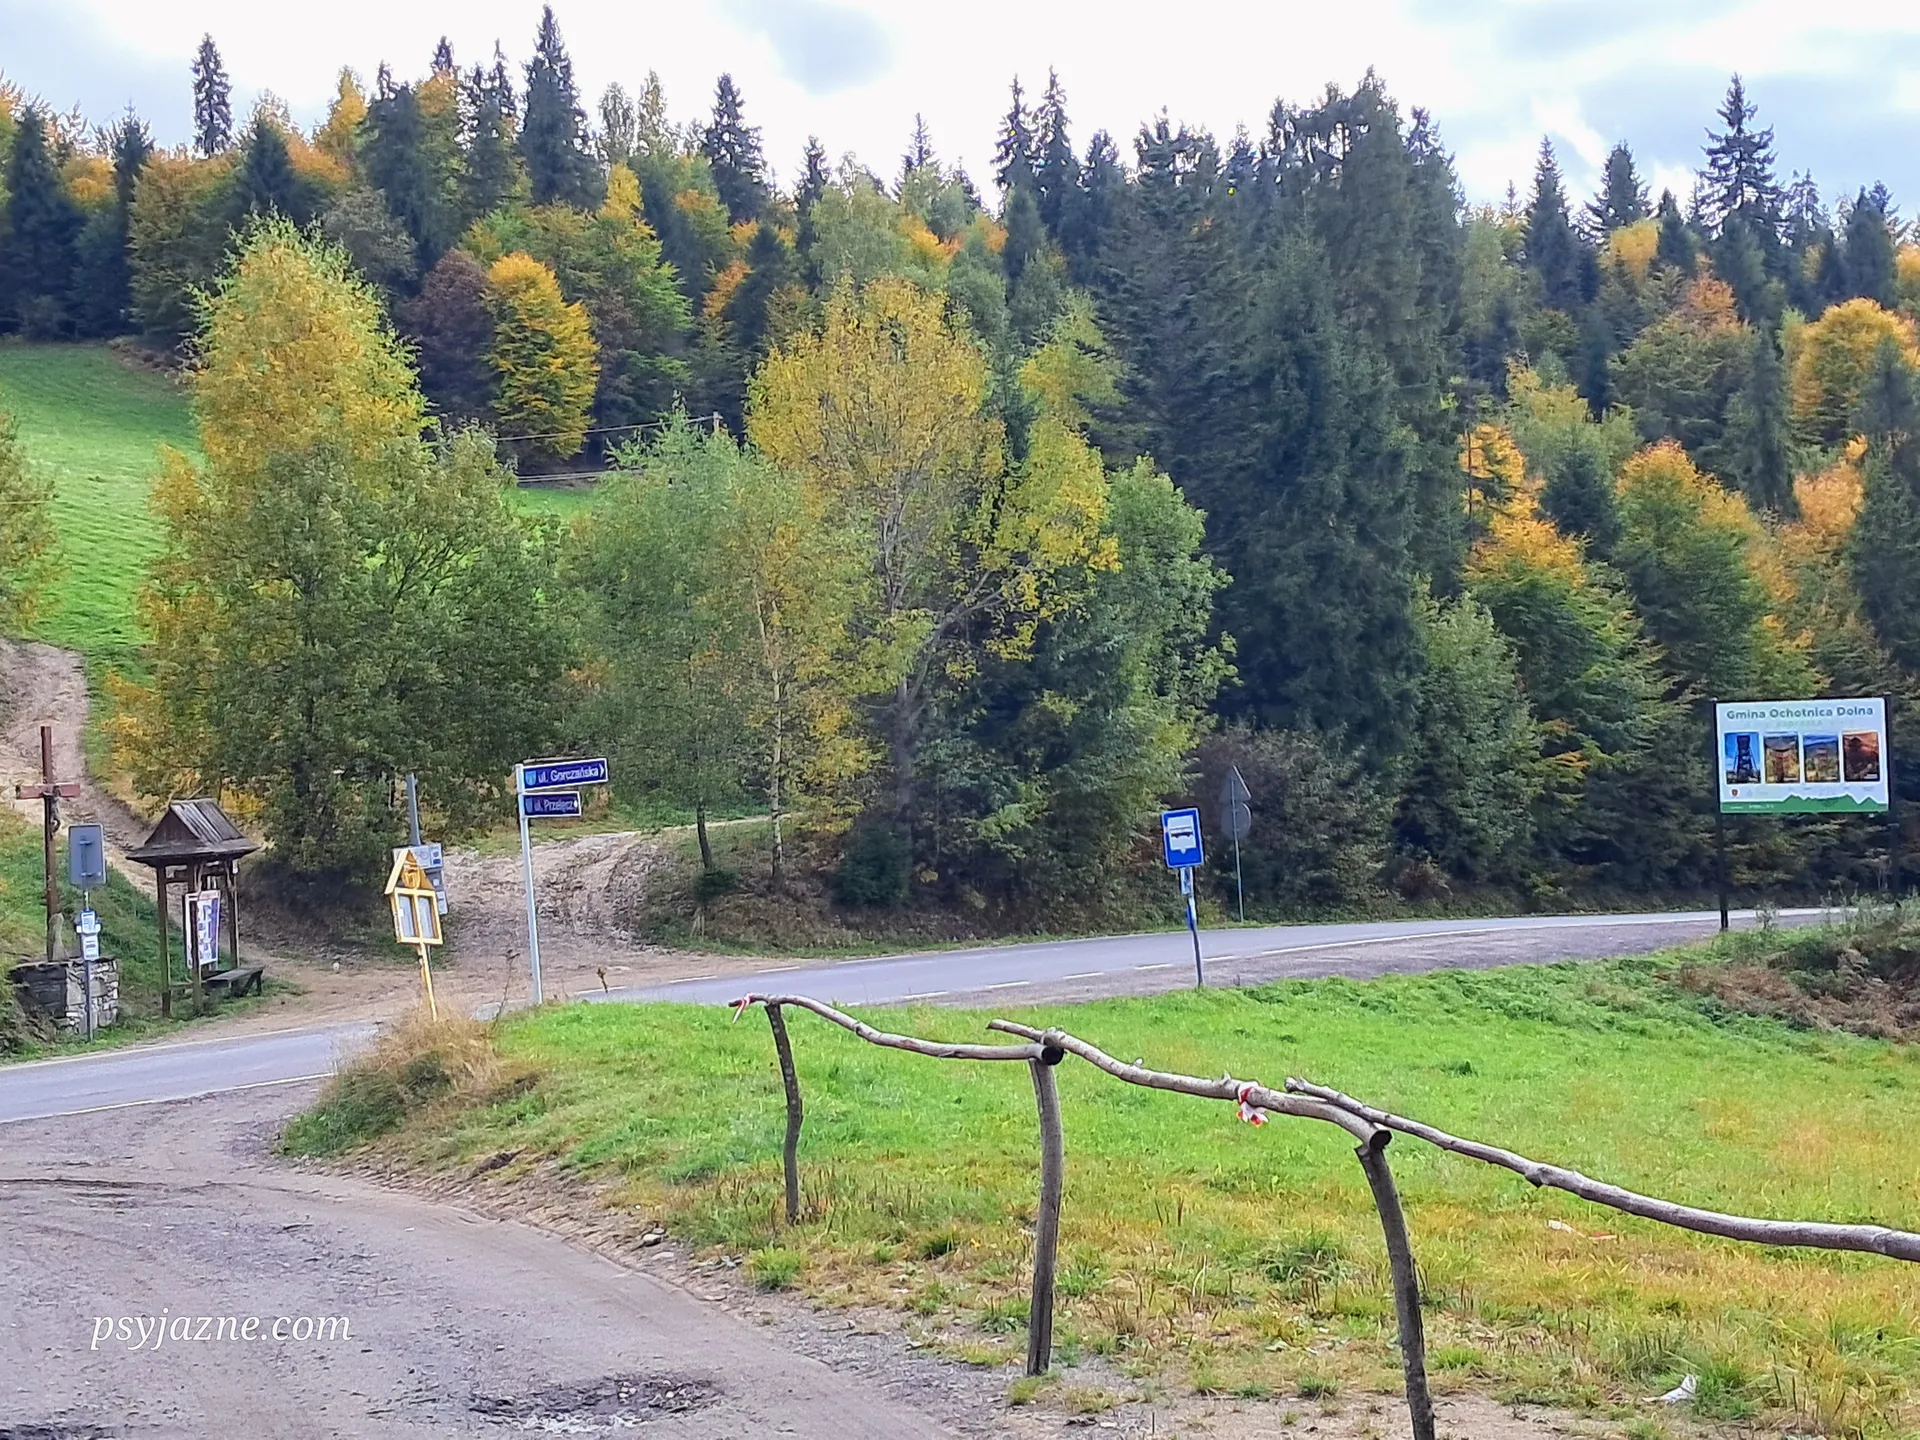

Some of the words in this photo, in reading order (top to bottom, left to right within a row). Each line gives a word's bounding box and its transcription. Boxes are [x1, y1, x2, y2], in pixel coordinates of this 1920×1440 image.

[1726, 709, 1766, 720] Gmina
[1769, 707, 1833, 719] Ochotnica
[1836, 706, 1874, 717] Dolna
